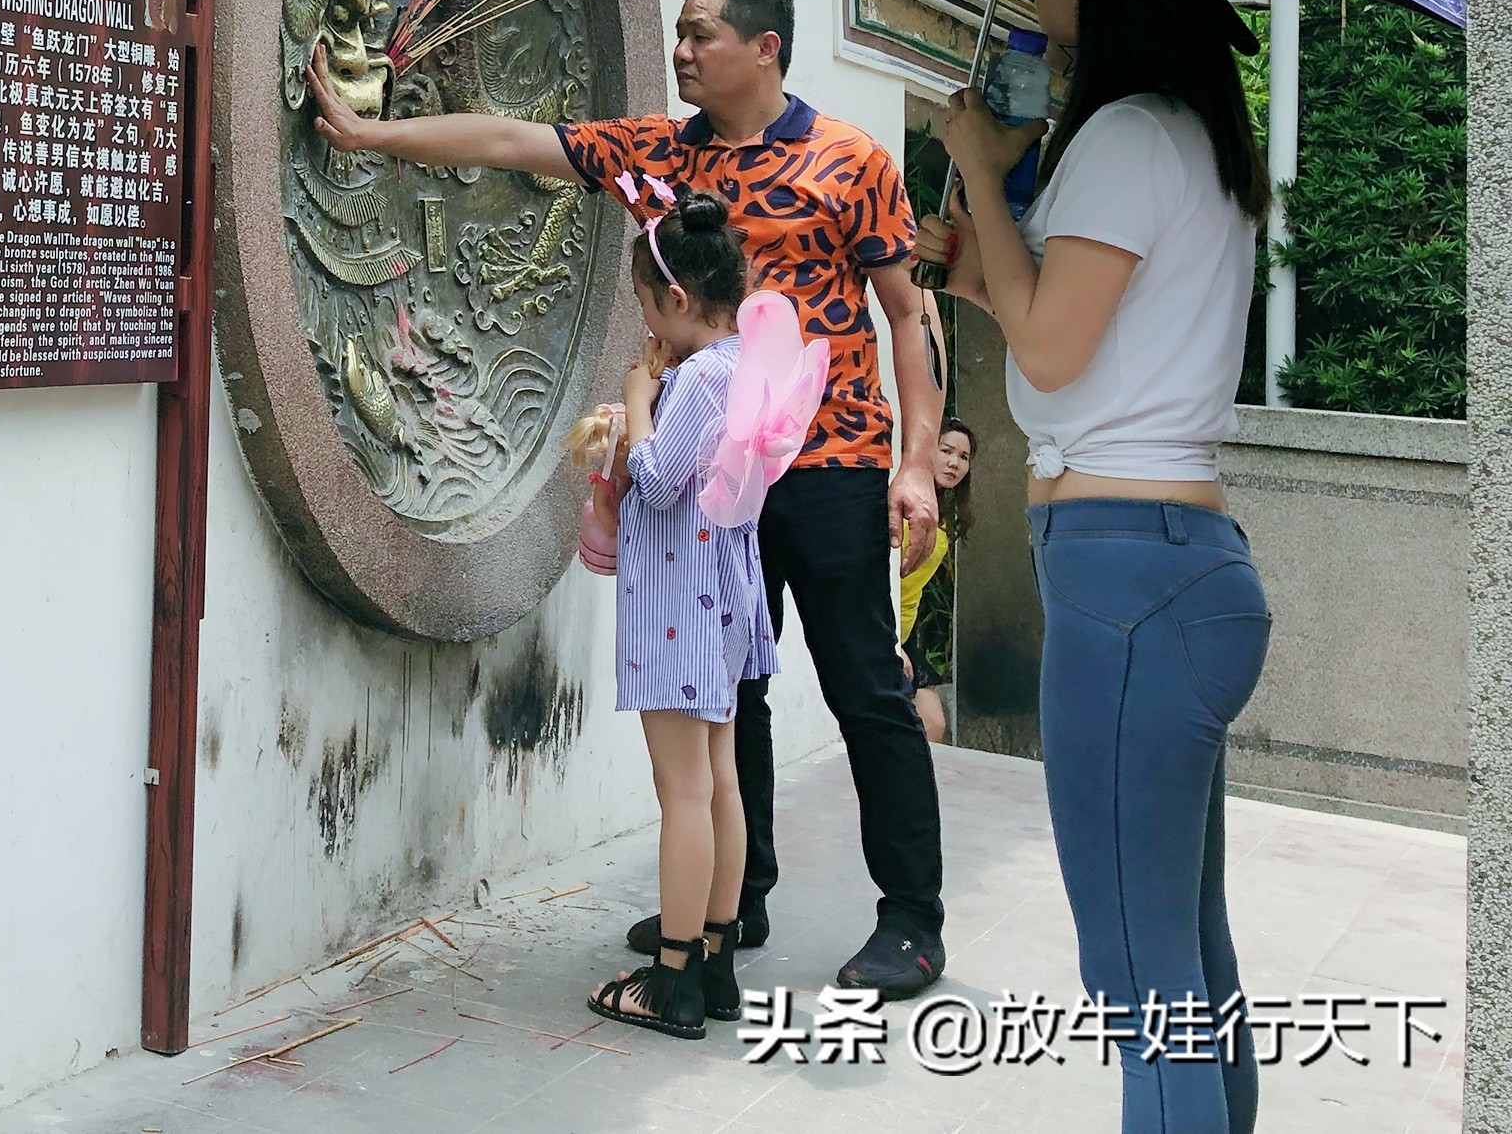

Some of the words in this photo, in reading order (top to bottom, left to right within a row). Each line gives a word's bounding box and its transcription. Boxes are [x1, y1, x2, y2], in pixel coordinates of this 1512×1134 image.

[105, 2, 134, 31] WALL
[7, 231, 41, 246] Dragon
[83, 234, 114, 249] dragon
[116, 236, 133, 248] wall
[162, 238, 168, 249] is
[171, 241, 175, 250] a
[4, 245, 36, 259] bronze
[39, 248, 90, 263] sculptures,
[94, 250, 126, 261] created
[129, 251, 137, 262] in
[140, 251, 152, 262] the
[155, 251, 175, 265] Ming
[10, 260, 34, 274] sixth
[36, 264, 56, 276] year
[58, 262, 88, 275] (1578),
[90, 263, 106, 275] and
[108, 264, 143, 278] repaired
[145, 264, 152, 276] in
[154, 265, 175, 276] 1986.
[31, 276, 46, 288] the
[50, 276, 69, 288] God
[73, 276, 82, 288] of
[85, 277, 111, 289] arctic
[114, 277, 135, 289] Zhen
[138, 278, 152, 289] Wu
[155, 278, 174, 290] Yuan
[9, 290, 41, 305] signed
[46, 293, 57, 303] an
[62, 291, 94, 303] article:
[136, 292, 162, 305] rolling
[166, 292, 174, 303] in
[45, 306, 55, 317] to
[103, 306, 112, 317] to
[116, 305, 157, 319] symbolize
[161, 306, 173, 317] the
[32, 322, 55, 332] were
[60, 319, 78, 331] told
[83, 320, 101, 332] that
[105, 320, 116, 334] by
[120, 319, 156, 333] touching
[160, 319, 173, 331] the
[0, 334, 34, 349] feeling
[38, 334, 54, 346] the
[57, 334, 85, 348] spirit,
[89, 334, 106, 346] and
[109, 333, 140, 347] making
[144, 333, 173, 344] sincere
[9, 350, 22, 362] be
[23, 349, 59, 362] blessed
[61, 348, 81, 360] with
[83, 347, 129, 362] auspicious
[130, 349, 156, 361] power
[157, 346, 172, 358] and
